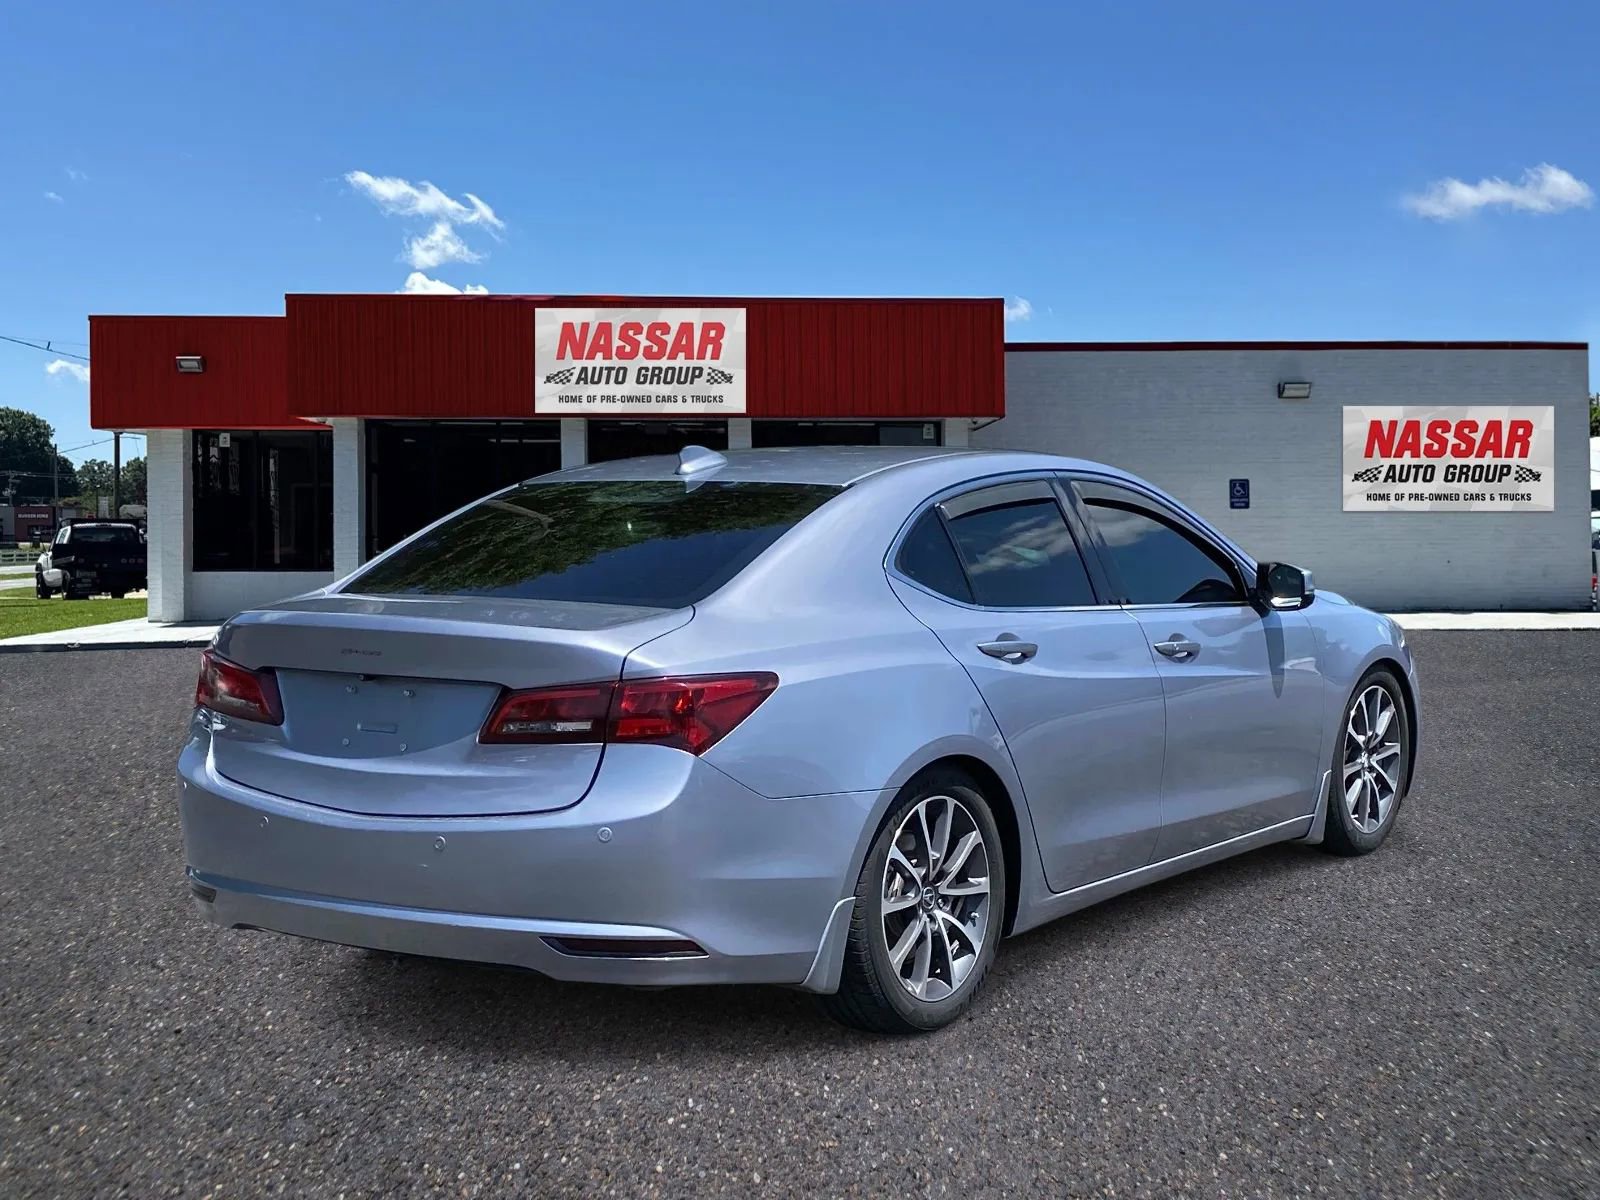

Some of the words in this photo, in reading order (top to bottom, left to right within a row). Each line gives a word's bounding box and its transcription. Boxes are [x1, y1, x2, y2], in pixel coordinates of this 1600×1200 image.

[556, 321, 726, 361] NASSAR
[575, 366, 628, 385] AUTO
[635, 366, 704, 385] GROUP
[558, 394, 583, 404] HOME
[586, 394, 597, 404] OF
[600, 394, 652, 404] PRE-OWNED
[655, 394, 678, 404] CARS
[681, 394, 688, 404] &
[690, 394, 724, 404] TRUCKS
[1364, 419, 1534, 459] NASSAR
[1383, 464, 1436, 483] AUTO
[1443, 464, 1512, 483] GROUP
[1366, 492, 1391, 502] HOME
[1394, 492, 1406, 502] OF
[1408, 492, 1460, 502] PRE-OWNED
[1463, 492, 1486, 502] CARS
[1489, 492, 1496, 502] &
[1499, 492, 1532, 502] TRUCKS
